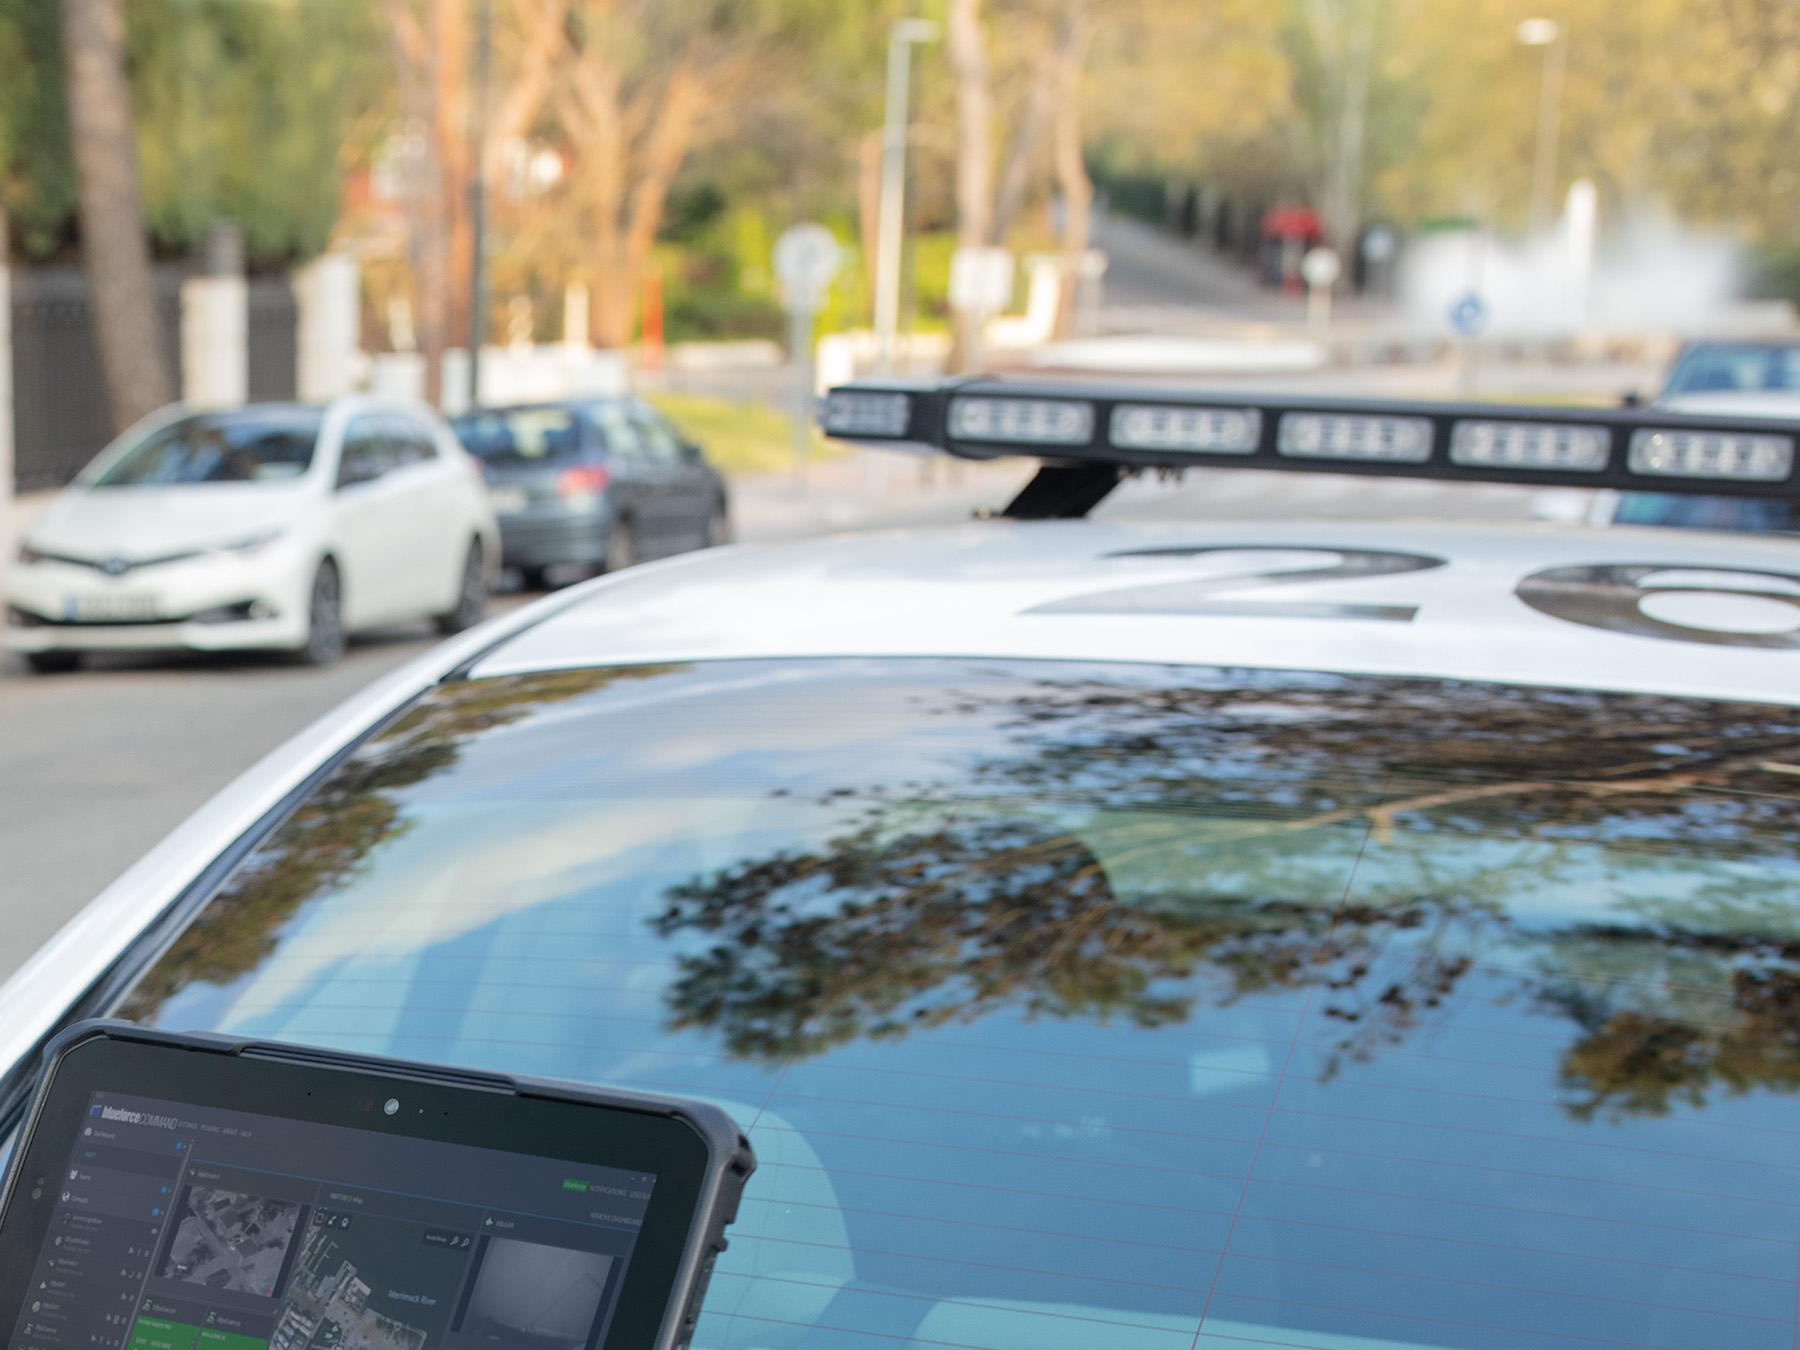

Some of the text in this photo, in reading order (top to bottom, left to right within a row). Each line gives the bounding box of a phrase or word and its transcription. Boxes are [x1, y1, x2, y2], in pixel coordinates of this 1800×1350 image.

[589, 1184, 626, 1196] NOTIFICATIONS
[387, 1290, 438, 1306] Merrimack River
